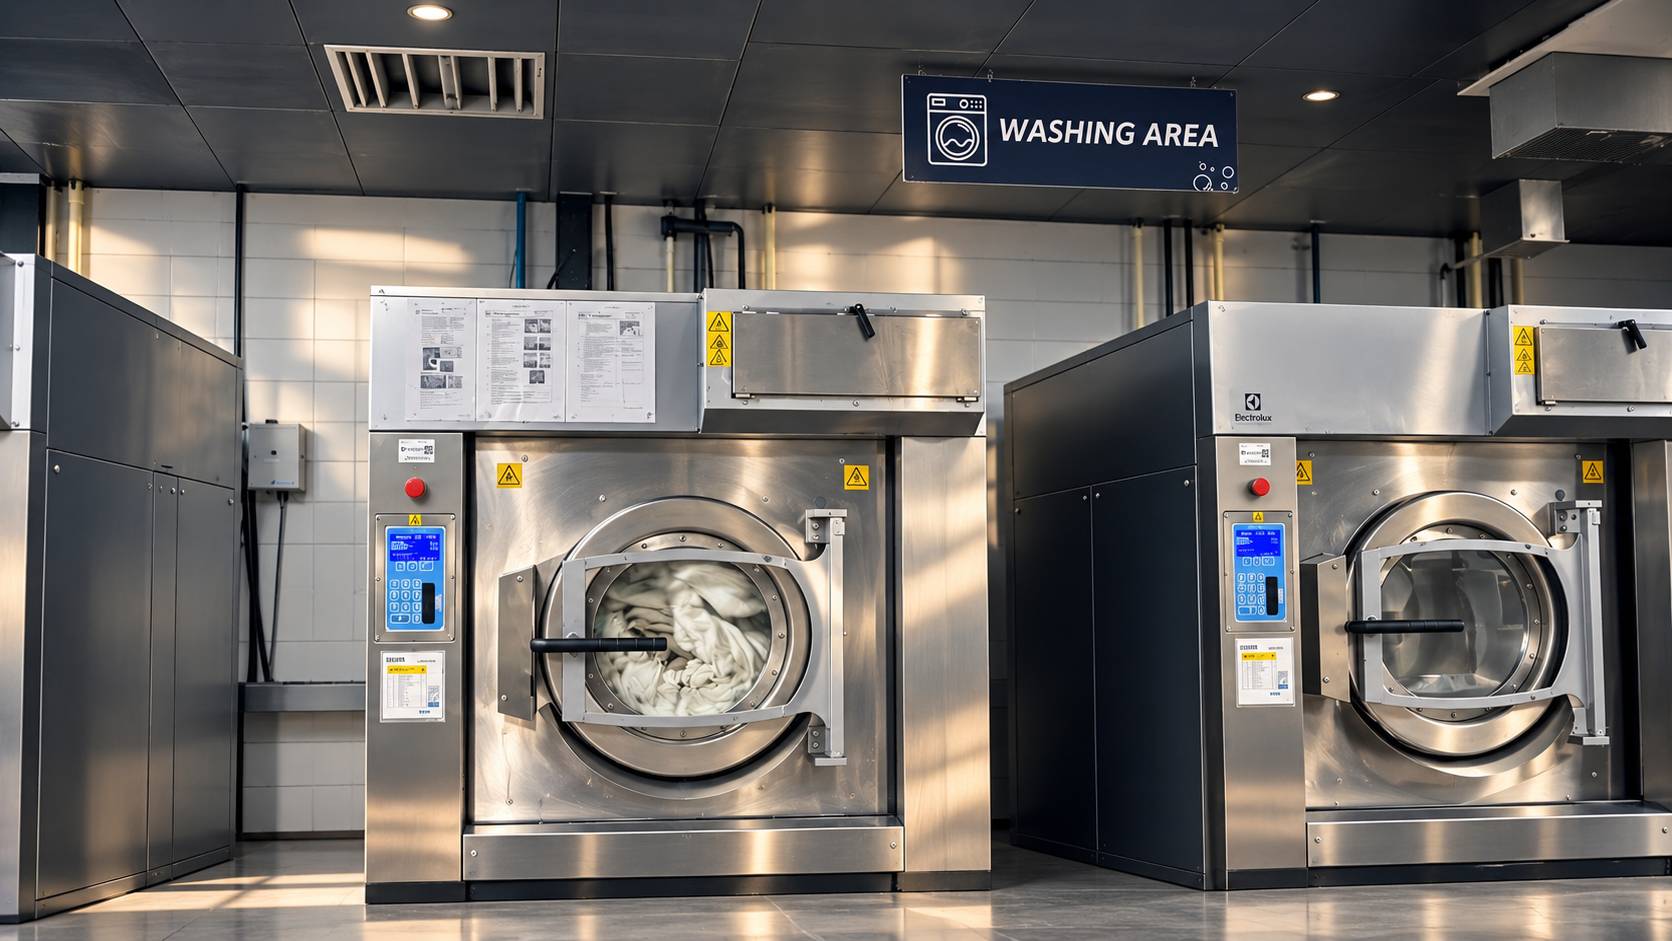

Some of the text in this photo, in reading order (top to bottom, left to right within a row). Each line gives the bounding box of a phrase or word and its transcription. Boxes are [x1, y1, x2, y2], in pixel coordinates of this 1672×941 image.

[1000, 118, 1219, 147] WASHING AREA
[1235, 413, 1272, 421] Electrolux
